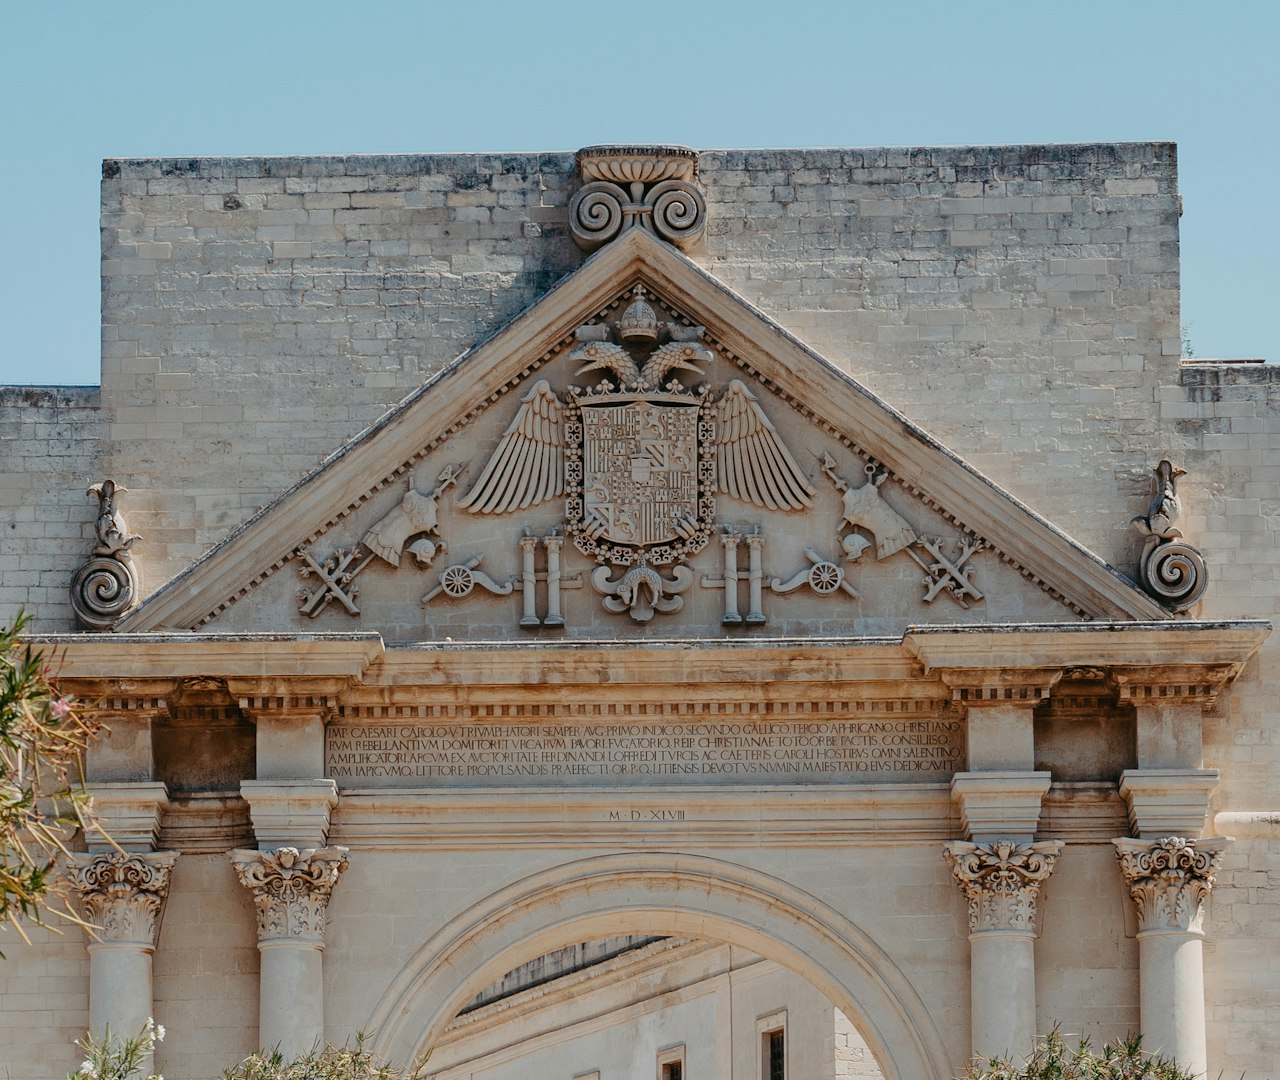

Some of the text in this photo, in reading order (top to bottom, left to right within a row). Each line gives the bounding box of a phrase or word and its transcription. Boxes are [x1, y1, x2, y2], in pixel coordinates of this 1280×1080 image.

[350, 727, 397, 738] CAESARI
[460, 726, 540, 738] TRIVMPHATORI
[542, 726, 580, 737] SEMPER
[606, 725, 640, 736] PRIMO
[686, 724, 741, 736] SECVNDO
[895, 721, 961, 733] CHRISTIANO
[329, 740, 352, 751] RVM
[355, 740, 438, 751] REBELLANTIVM
[504, 739, 567, 750] TVRCARVM
[698, 737, 774, 748] CHRISTIANAE
[776, 736, 809, 747] TOTO
[810, 735, 839, 746] ORBE
[410, 753, 449, 763] ARCVM
[452, 752, 465, 763] EX
[469, 752, 538, 763] AVCTORITATE
[542, 751, 605, 762] FERDINANDI
[608, 750, 657, 762] LOFFREDI
[658, 750, 699, 761] TVRCIS
[702, 750, 717, 761] AC
[720, 749, 772, 760] CAETERIS
[774, 749, 814, 760] CAROLI
[817, 748, 869, 759] HOSTIBVS
[872, 747, 901, 758] OMNI
[903, 747, 961, 758] SALENTINO
[330, 766, 352, 776] RVM
[416, 765, 464, 776] LITTORE
[467, 765, 548, 775] PROPVLSANDIS
[702, 763, 757, 774] DEVOTVS
[759, 762, 800, 773] NVMINI
[870, 760, 892, 771] EIVS
[893, 760, 956, 771] DEDICAVIT
